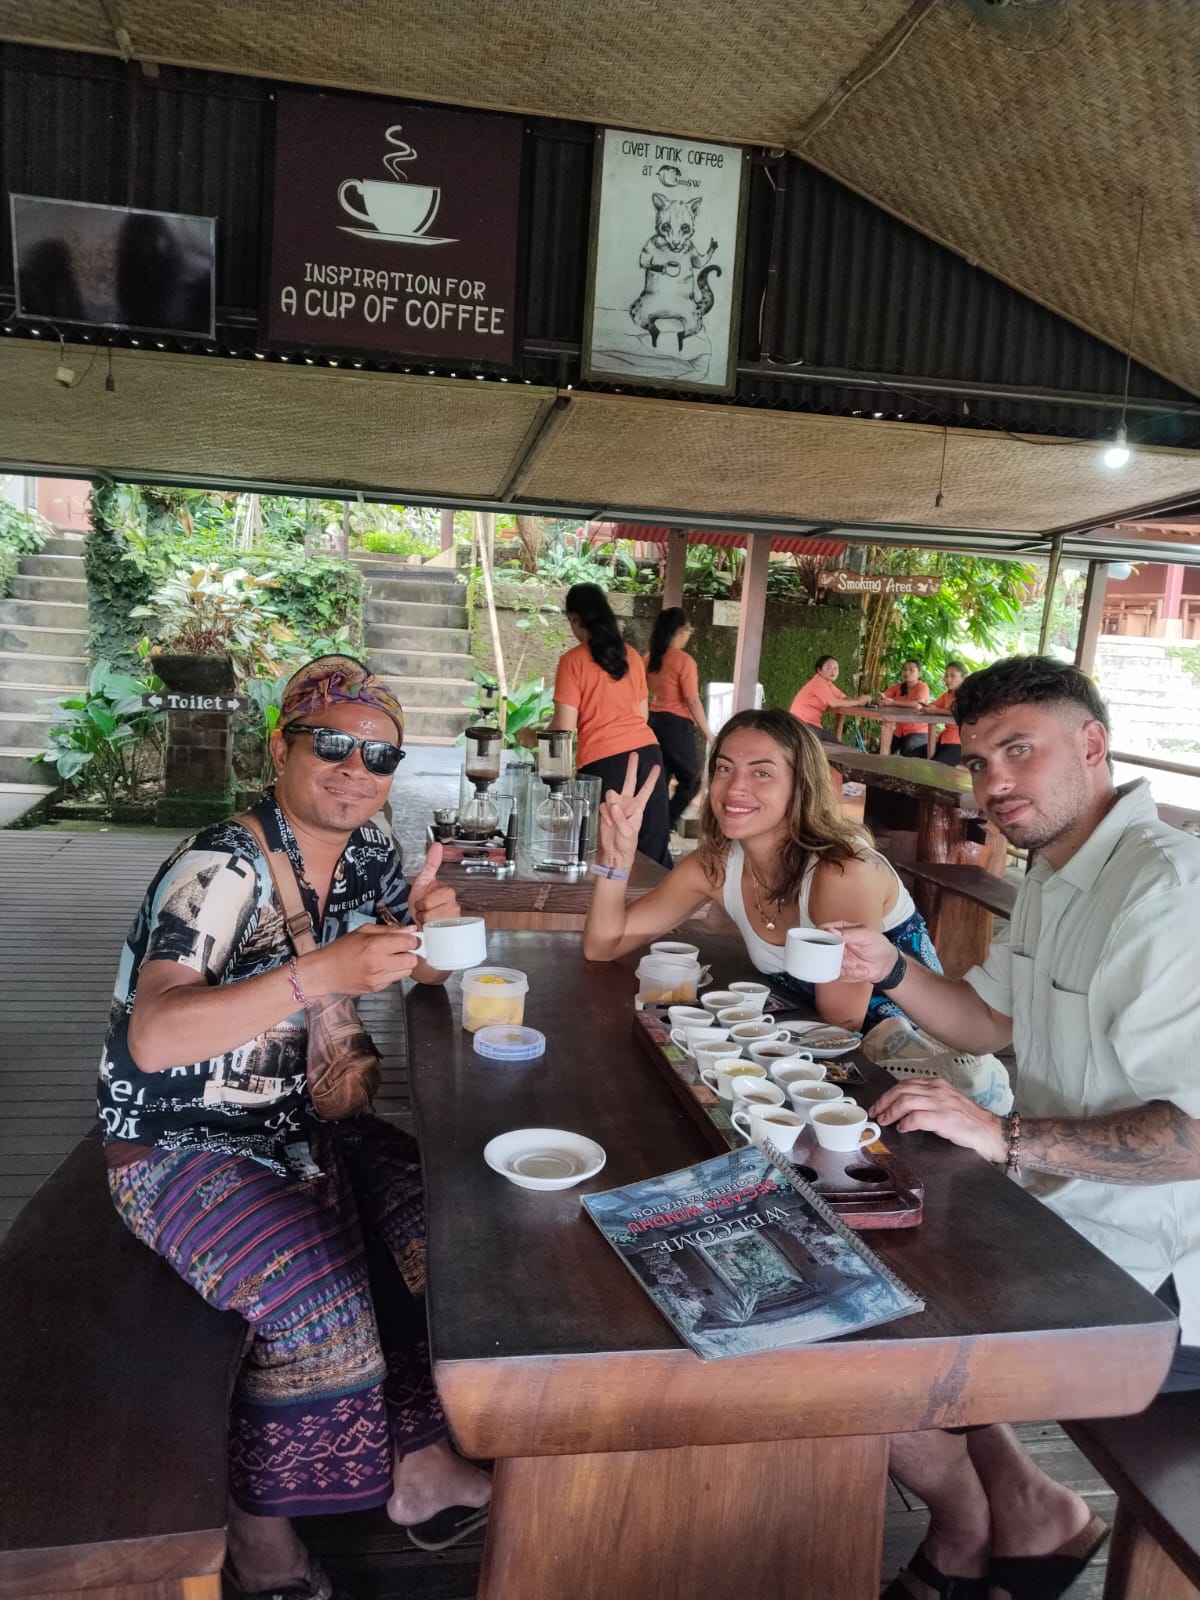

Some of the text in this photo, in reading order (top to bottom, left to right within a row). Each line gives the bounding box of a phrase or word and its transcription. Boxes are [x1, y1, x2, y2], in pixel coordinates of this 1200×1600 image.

[304, 263, 487, 300] INSPIRATION FOR
[281, 286, 505, 335] A CUP OF COFFEE
[838, 573, 913, 593] Smoking Area
[167, 695, 223, 710] Toilet
[626, 1179, 779, 1235] SEGARA WINDHU
[631, 1174, 759, 1220] COFFEE PLANTATION
[653, 1206, 791, 1255] WELCOME
[703, 1214, 723, 1225] TO
